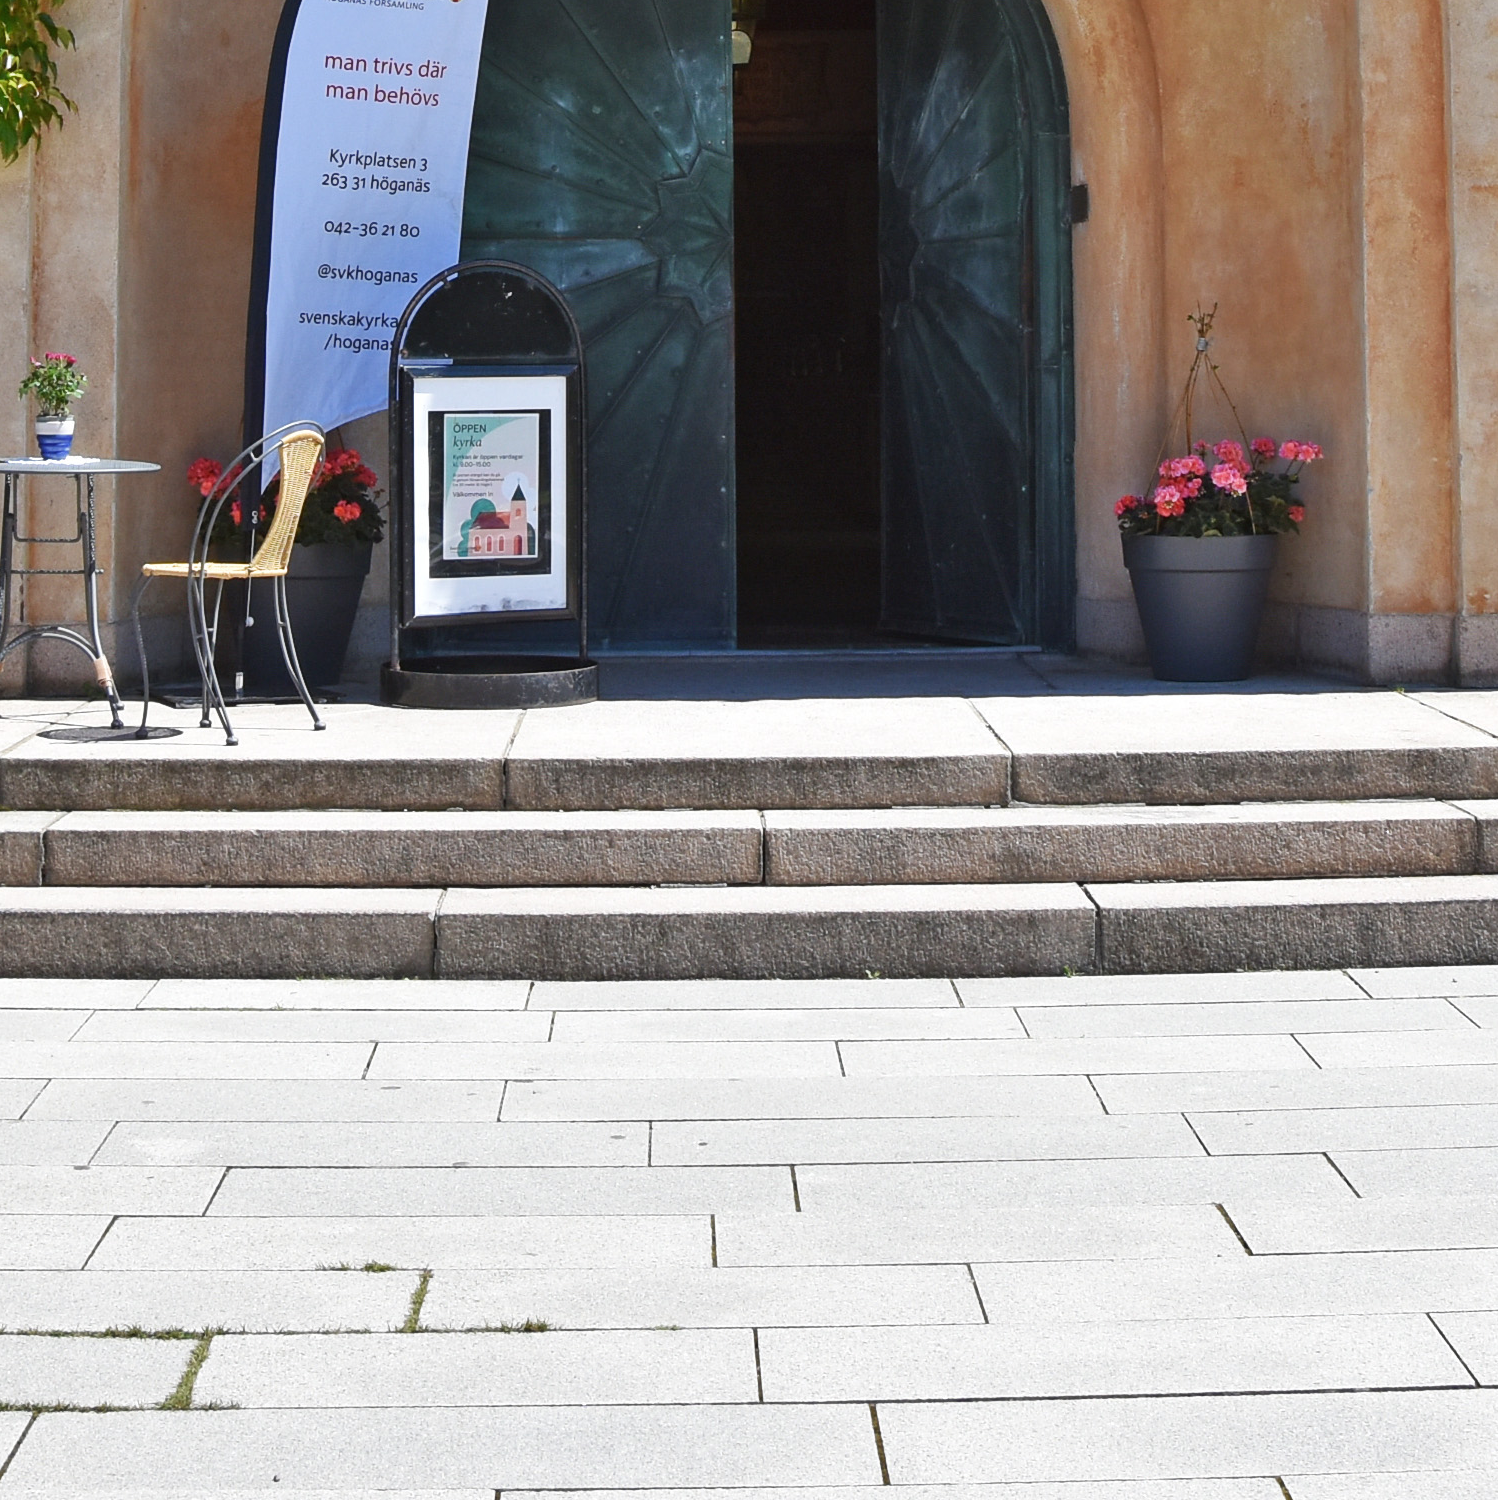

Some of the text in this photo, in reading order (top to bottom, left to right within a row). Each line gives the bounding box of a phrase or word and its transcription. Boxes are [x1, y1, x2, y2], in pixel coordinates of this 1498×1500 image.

[325, 55, 447, 78] man trivs där
[326, 84, 439, 107] man behövs
[329, 149, 428, 172] Kyrkplatsen 3
[321, 173, 431, 195] 263 31 höganäs
[324, 221, 420, 237] 042-36 21 80
[317, 264, 419, 286] @svkhoganas
[299, 310, 407, 331] svenskakyrka
[453, 422, 487, 433] ÖPPEN
[452, 435, 482, 450] kyrka
